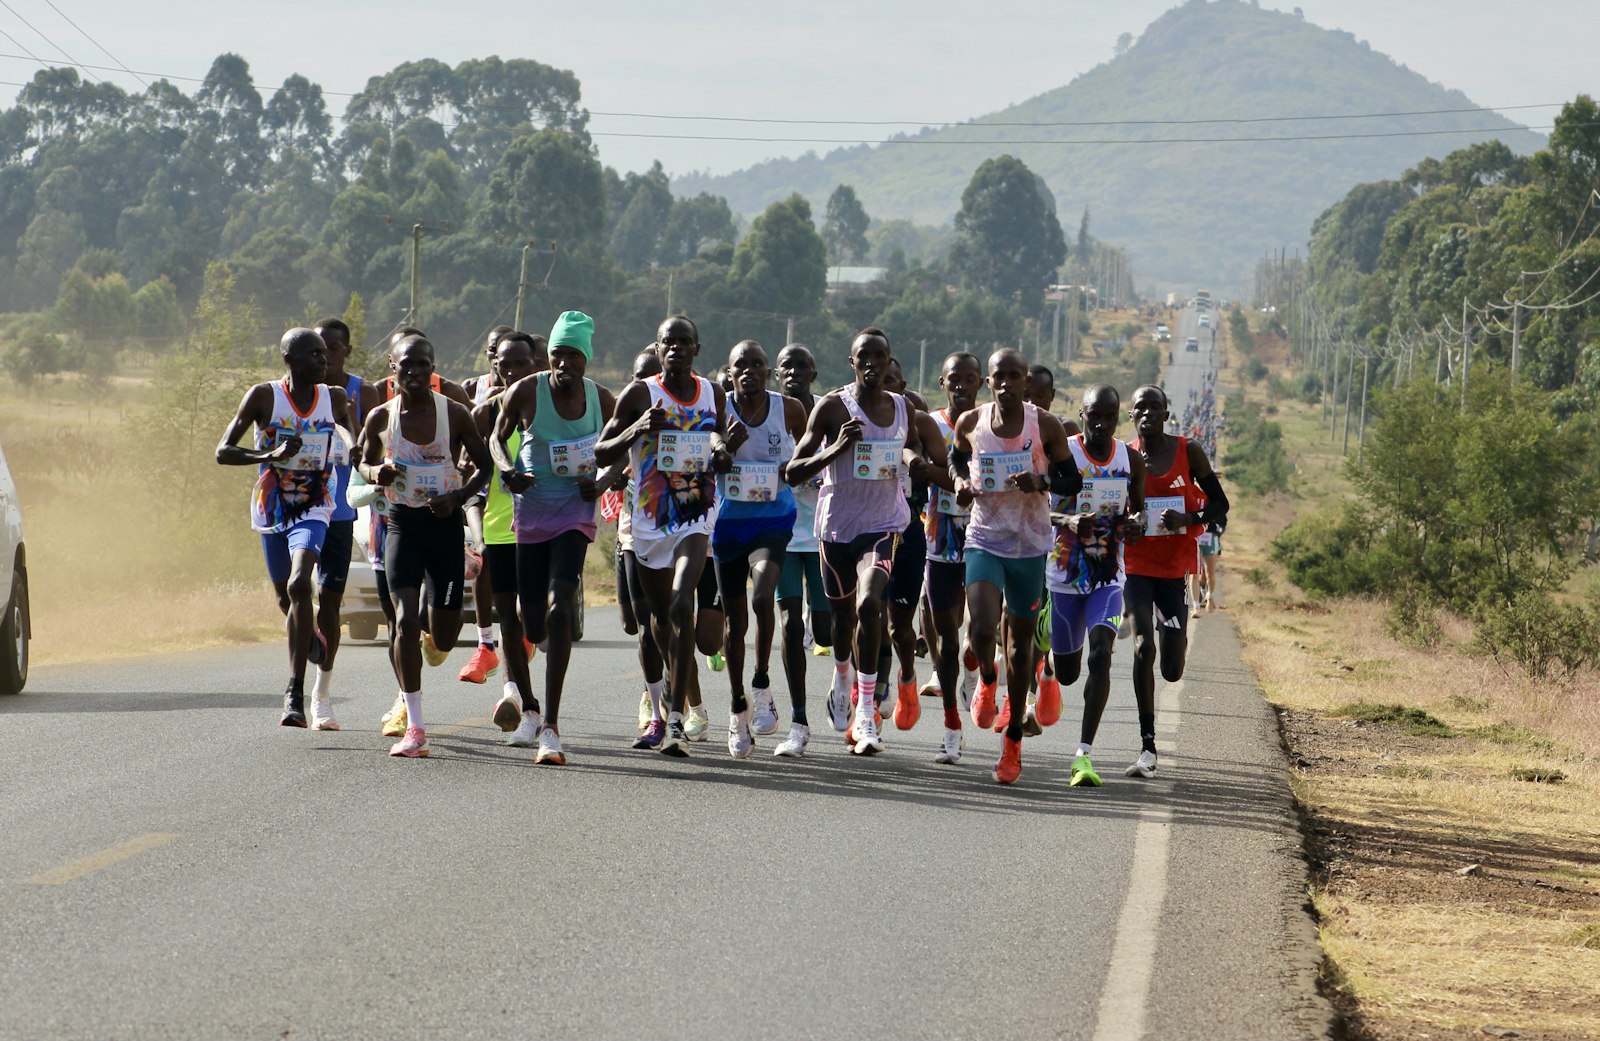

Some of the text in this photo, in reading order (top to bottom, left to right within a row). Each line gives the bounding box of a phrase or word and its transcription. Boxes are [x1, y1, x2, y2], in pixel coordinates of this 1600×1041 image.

[680, 434, 710, 443] KELVIN
[301, 445, 322, 453] 279
[581, 448, 593, 459] 59
[689, 445, 702, 454] 39
[884, 452, 895, 462] 81
[997, 454, 1030, 464] BENARD
[1006, 464, 1023, 474] 191
[416, 475, 437, 485] 312
[754, 475, 767, 484] 13
[1101, 490, 1121, 499] 295
[1151, 500, 1184, 508] GIDEON
